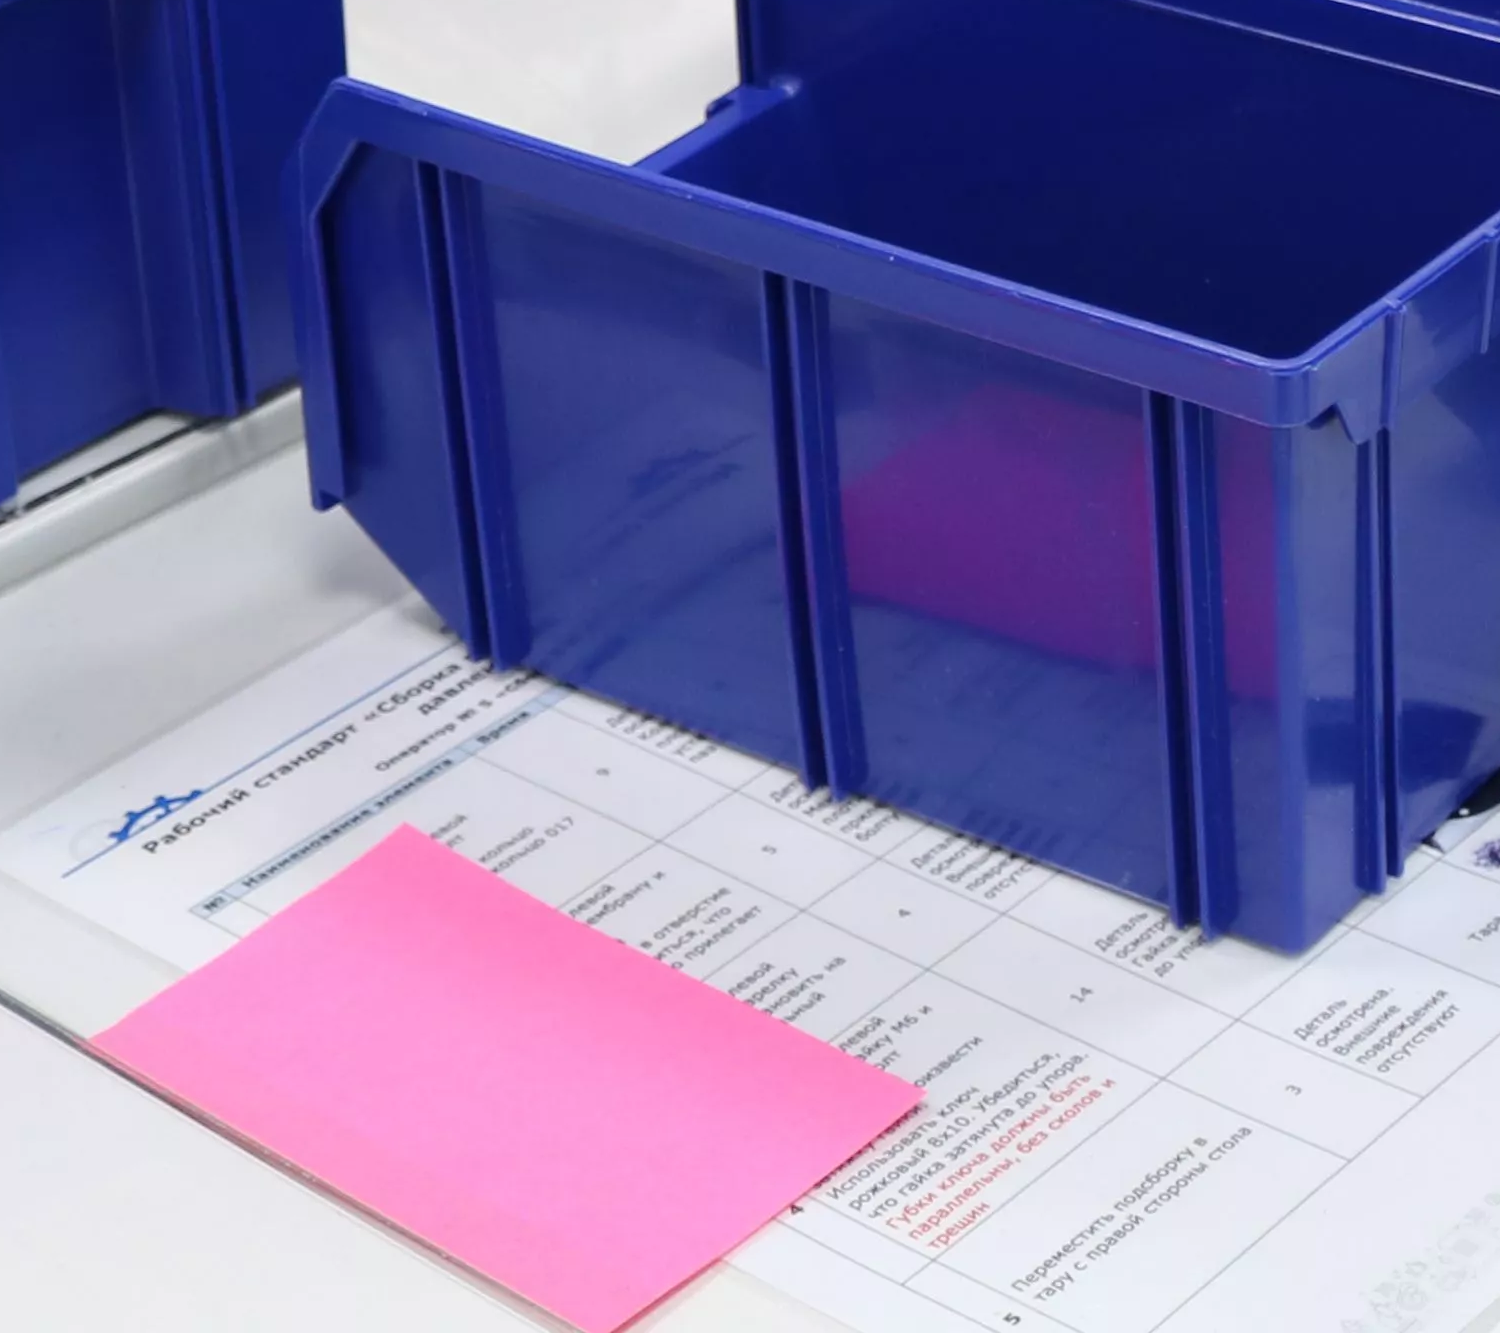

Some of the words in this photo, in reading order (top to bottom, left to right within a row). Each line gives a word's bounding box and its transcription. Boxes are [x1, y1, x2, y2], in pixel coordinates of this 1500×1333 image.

[417, 663, 495, 717] давлен
[141, 787, 252, 855] Рабочий
[252, 722, 359, 790] стандарт
[364, 663, 463, 723] «Сборка
[374, 721, 457, 774] Оператор
[761, 844, 778, 856] 5
[585, 879, 653, 927] ембрану
[653, 886, 733, 941] отверстие
[653, 928, 706, 962] иться,
[703, 906, 733, 926] что
[684, 904, 763, 962] прилегает
[1093, 910, 1150, 953] Деталь
[1114, 913, 1171, 960] осмотр
[1130, 933, 1181, 968] Гайка
[726, 961, 776, 998] левой
[743, 967, 800, 1008] арелку
[824, 955, 848, 974] на
[1152, 960, 1176, 978] до
[1069, 986, 1095, 1004] 14
[1293, 998, 1349, 1042] Деталь
[1315, 986, 1396, 1049] осмотрена.
[838, 1015, 887, 1054] левой
[852, 1033, 894, 1063] айку
[1332, 1003, 1403, 1057] Внешние
[1354, 988, 1450, 1065] повреждения
[1375, 1003, 1461, 1074] отсутствуют
[873, 1049, 902, 1071] олт
[912, 1035, 985, 1089] оизвести
[1285, 1084, 1303, 1097] 3
[826, 1118, 939, 1202] Использовать
[937, 1085, 981, 1120] ключ
[867, 1197, 899, 1220] что
[898, 1160, 947, 1199] гайка
[943, 1106, 1015, 1162] затянута
[1014, 1089, 1037, 1110] до
[1035, 1052, 1091, 1092] упора.
[885, 1191, 938, 1232] Губки
[937, 1151, 990, 1192] ключа
[989, 1102, 1053, 1155] должны
[1048, 1072, 1093, 1104] быть
[907, 1156, 1023, 1241] параллельны,
[1015, 1130, 1050, 1155] без
[1047, 1088, 1104, 1132] сколов
[1100, 1076, 1117, 1090] и
[848, 1147, 931, 1212] рожковый
[788, 1203, 805, 1217] 4
[926, 1200, 992, 1251] трещин
[1010, 1211, 1117, 1294] Переместить
[1112, 1145, 1197, 1213] подсборку
[1192, 1136, 1209, 1148] в
[1033, 1270, 1076, 1303] тару
[1073, 1260, 1089, 1272] с
[1085, 1214, 1145, 1263] правой
[1143, 1161, 1210, 1216] стороны
[1207, 1125, 1254, 1162] стола
[1002, 1312, 1022, 1327] 5
